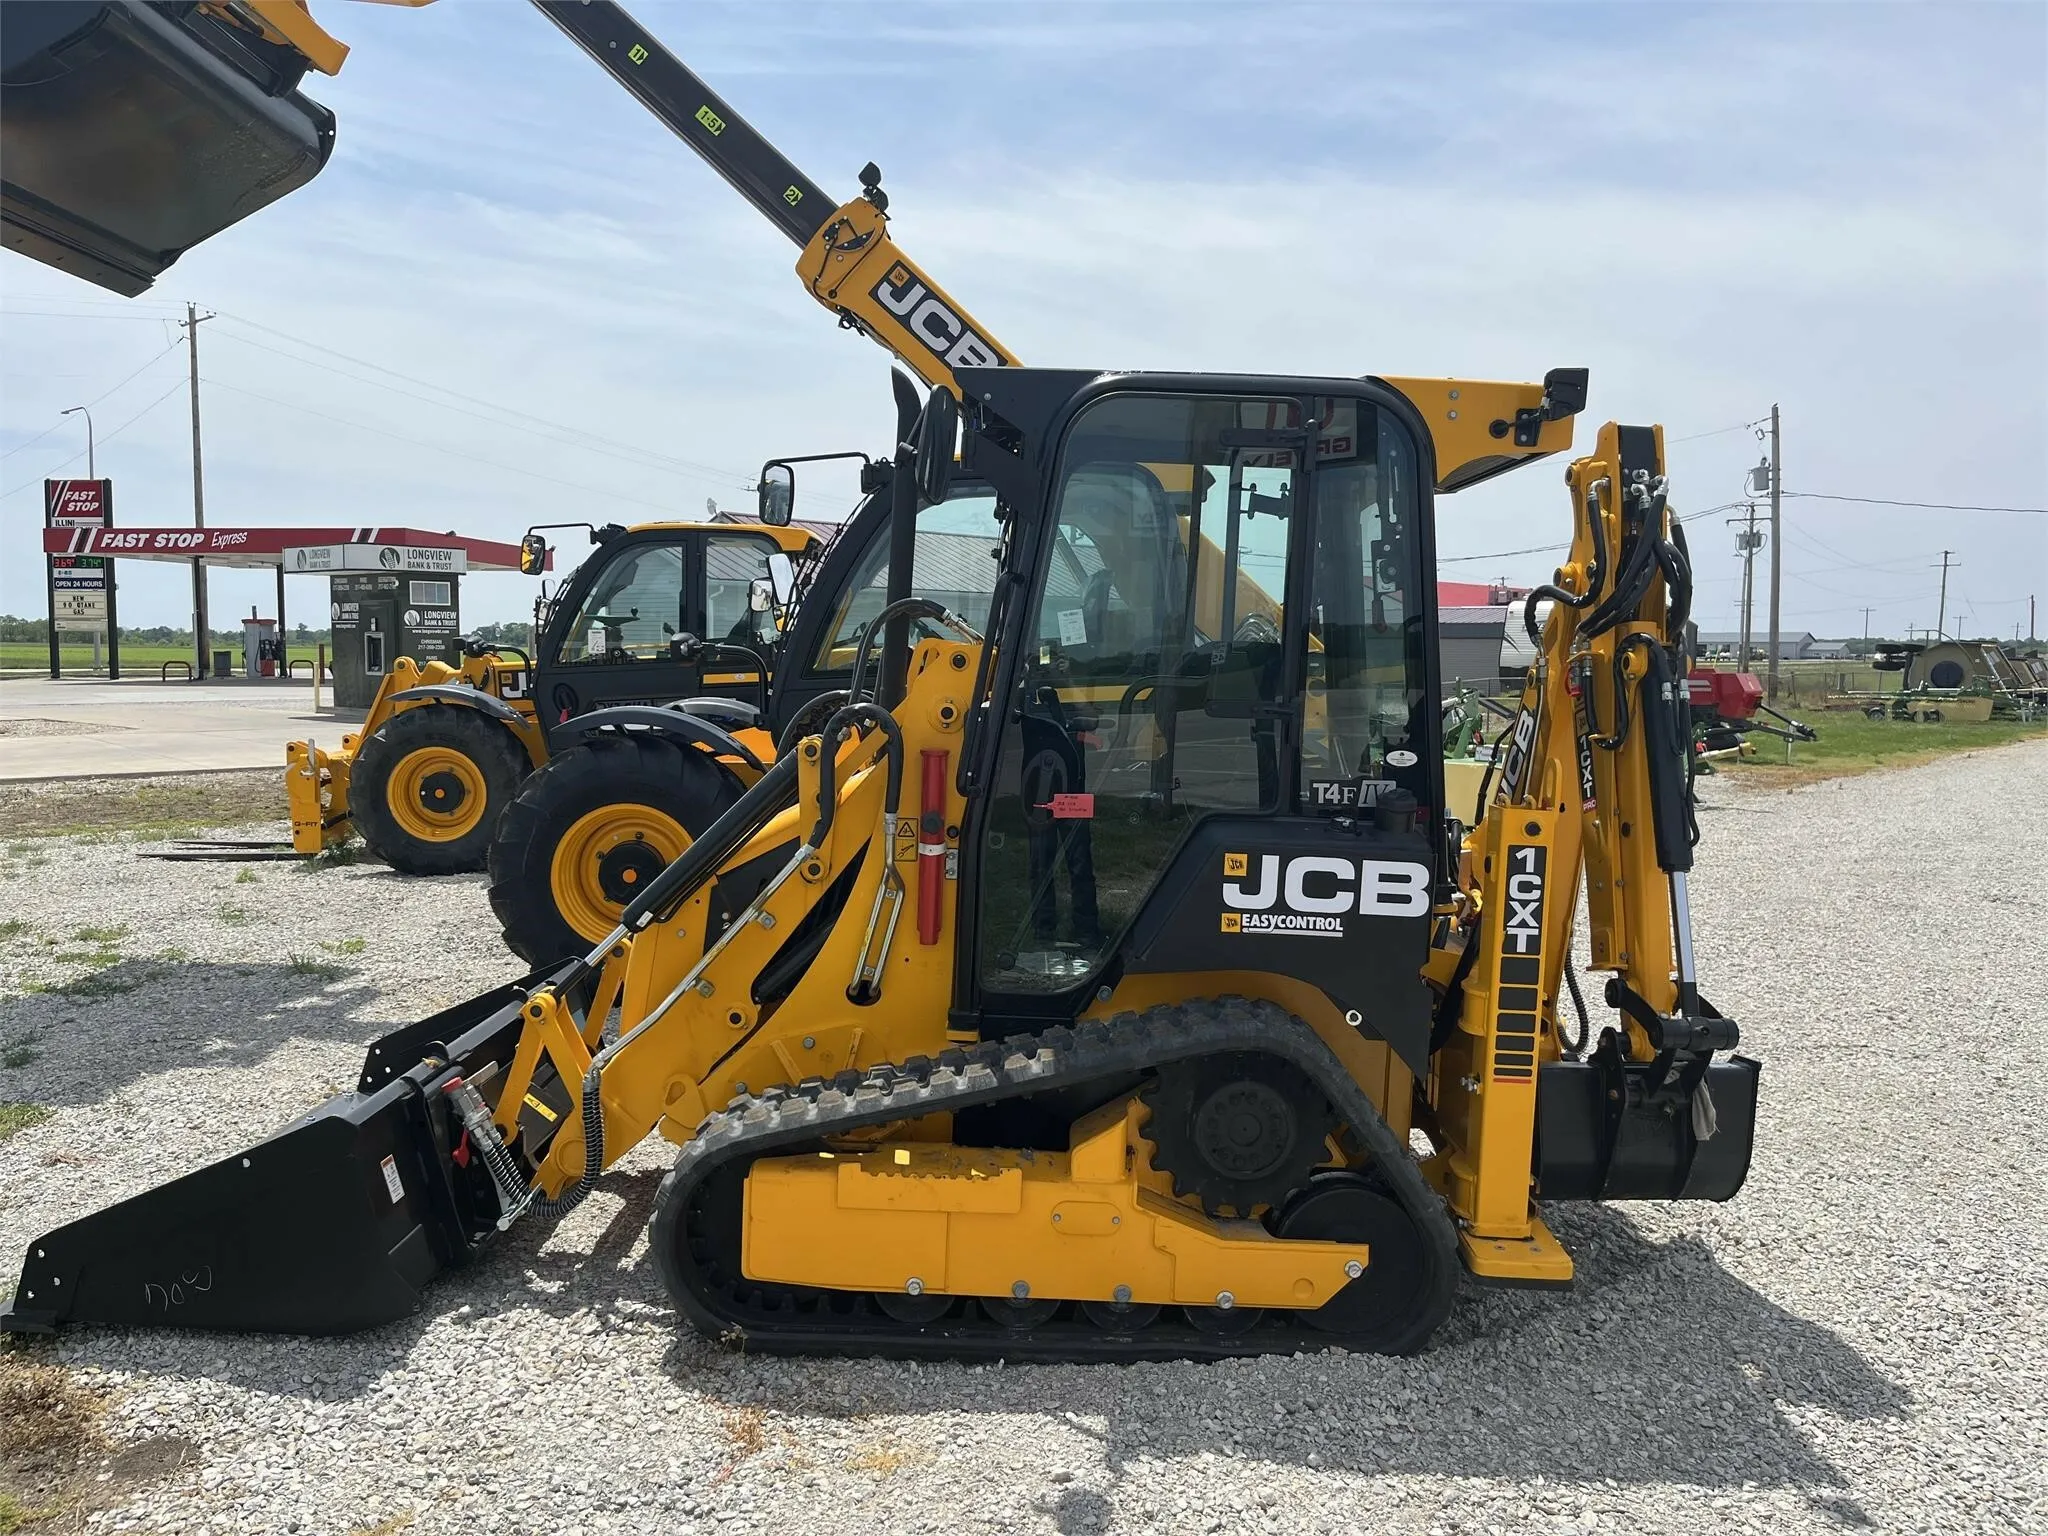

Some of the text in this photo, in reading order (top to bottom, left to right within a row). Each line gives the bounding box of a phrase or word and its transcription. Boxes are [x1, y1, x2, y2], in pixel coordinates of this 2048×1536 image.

[632, 48, 641, 58] 1
[785, 189, 795, 200] 2
[877, 281, 999, 367] JCB
[64, 491, 96, 501] FAST
[67, 502, 100, 512] STOP
[55, 519, 75, 527] ILLINI
[101, 531, 248, 549] FAST STOP Express
[407, 548, 452, 561] LONGVIEW
[407, 561, 452, 571] BANK & TRUST
[55, 580, 103, 588] OPEN 24 HOURS
[424, 610, 457, 620] LONGVIEW
[1580, 734, 1593, 798] 1CXT
[1583, 799, 1597, 813] PRO
[1222, 855, 1430, 918] JCB
[1506, 847, 1546, 953] 1CXT
[1242, 913, 1344, 932] EASYCONTROL
